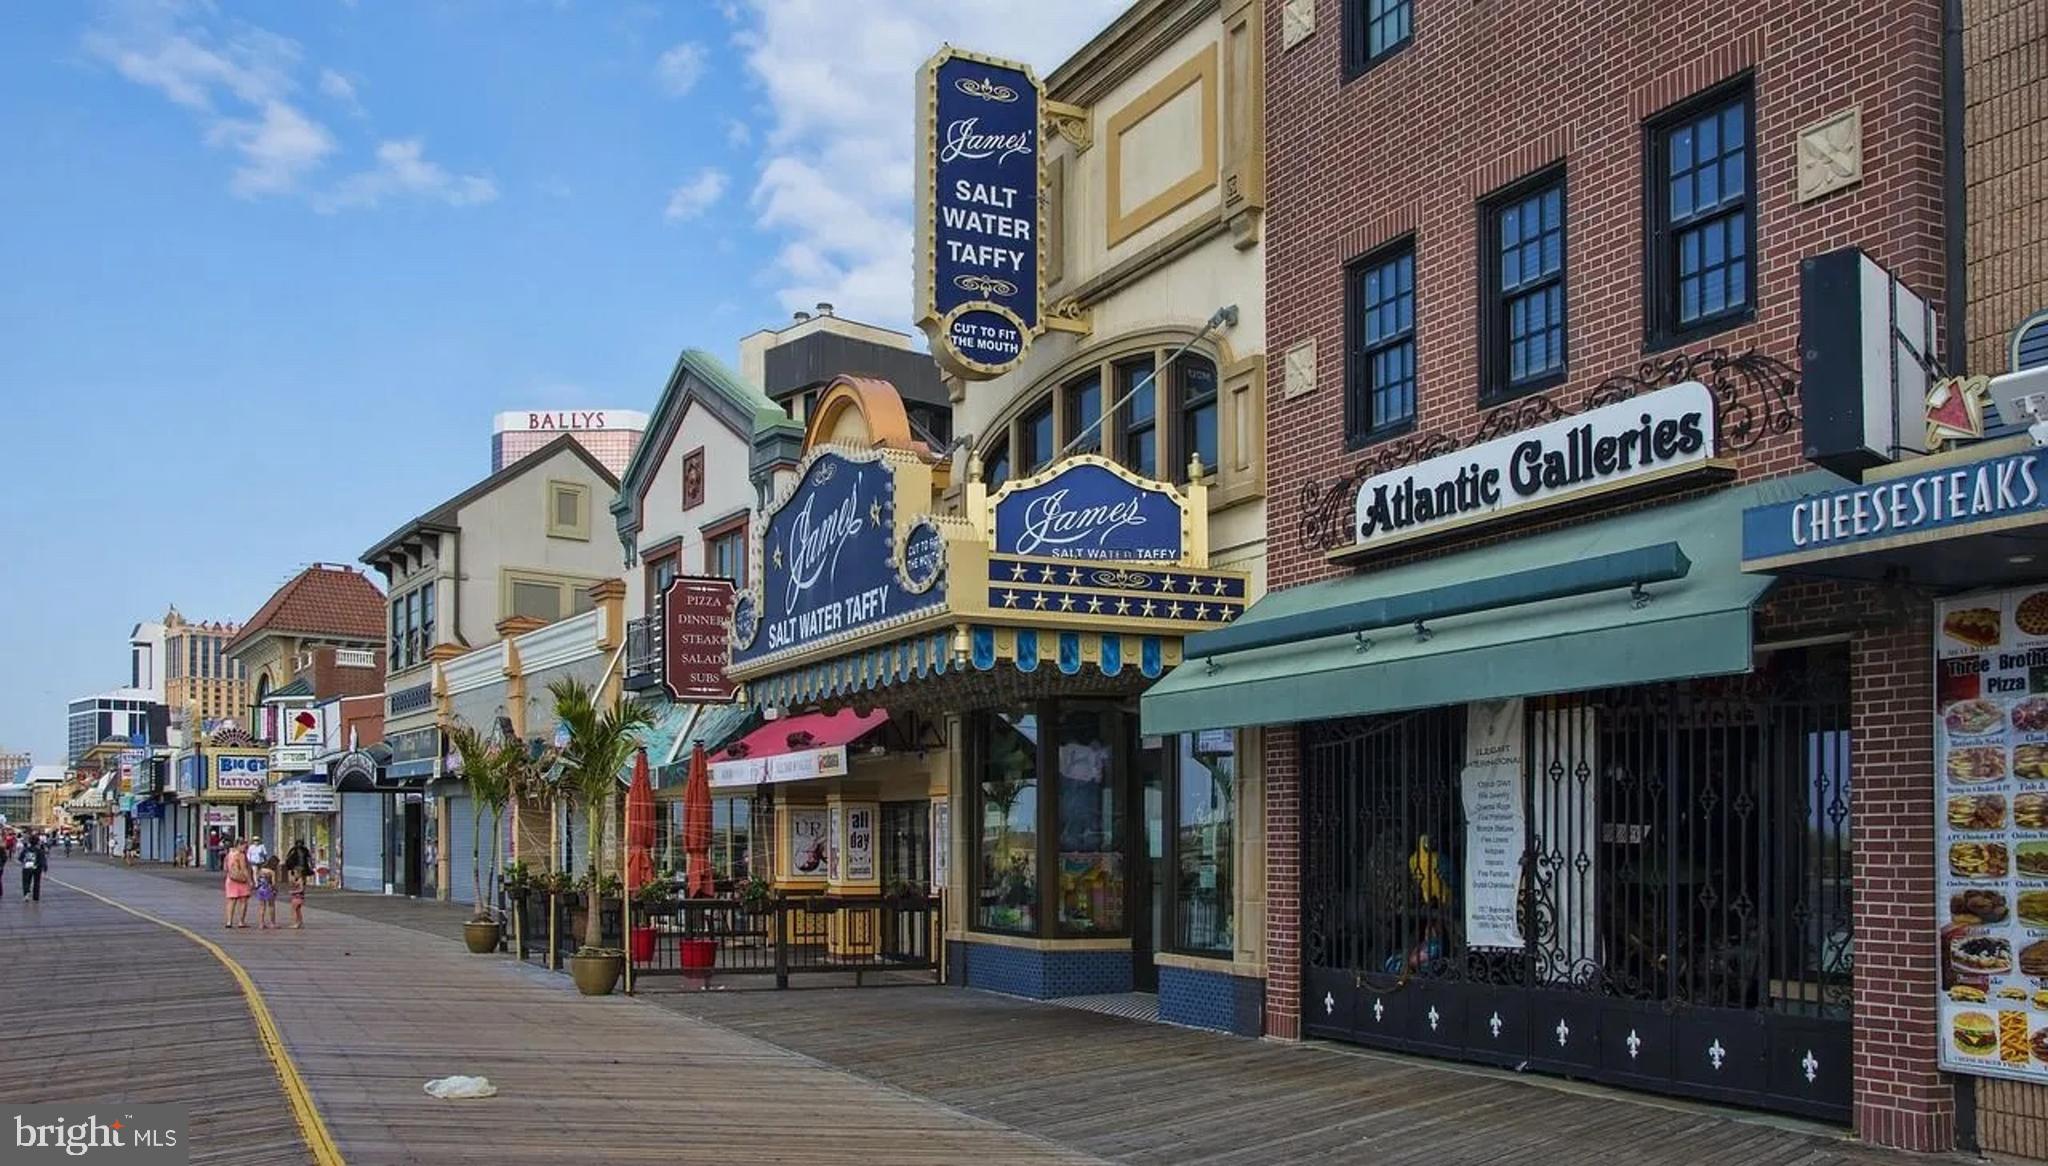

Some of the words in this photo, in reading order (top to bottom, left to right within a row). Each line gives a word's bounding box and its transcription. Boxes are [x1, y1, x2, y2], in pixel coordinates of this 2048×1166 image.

[955, 179, 1017, 209] SALT
[942, 206, 1031, 241] WATER
[946, 240, 1025, 272] TAFFY
[953, 322, 978, 335] CUT
[980, 326, 996, 338] TO
[998, 328, 1017, 341] FIT
[951, 335, 975, 348] THE
[977, 338, 1019, 355] MOUTH
[528, 411, 605, 430] BALLYS
[1361, 463, 1501, 538] Atlantic
[1509, 410, 1703, 496] Galleries
[1791, 454, 2039, 547] CHEESESTEAKS
[1051, 547, 1084, 560] SALT
[1136, 547, 1178, 560] TAFFY
[687, 595, 722, 607] PIZZA
[768, 617, 797, 650] SALT
[799, 601, 842, 640] WATER
[845, 584, 889, 625] TAFFY
[1947, 659, 1991, 675] Three
[690, 672, 720, 684] SUBS
[1987, 676, 2026, 694] Pizza
[220, 757, 246, 772] BIG
[851, 810, 869, 829] all
[850, 831, 870, 852] day
